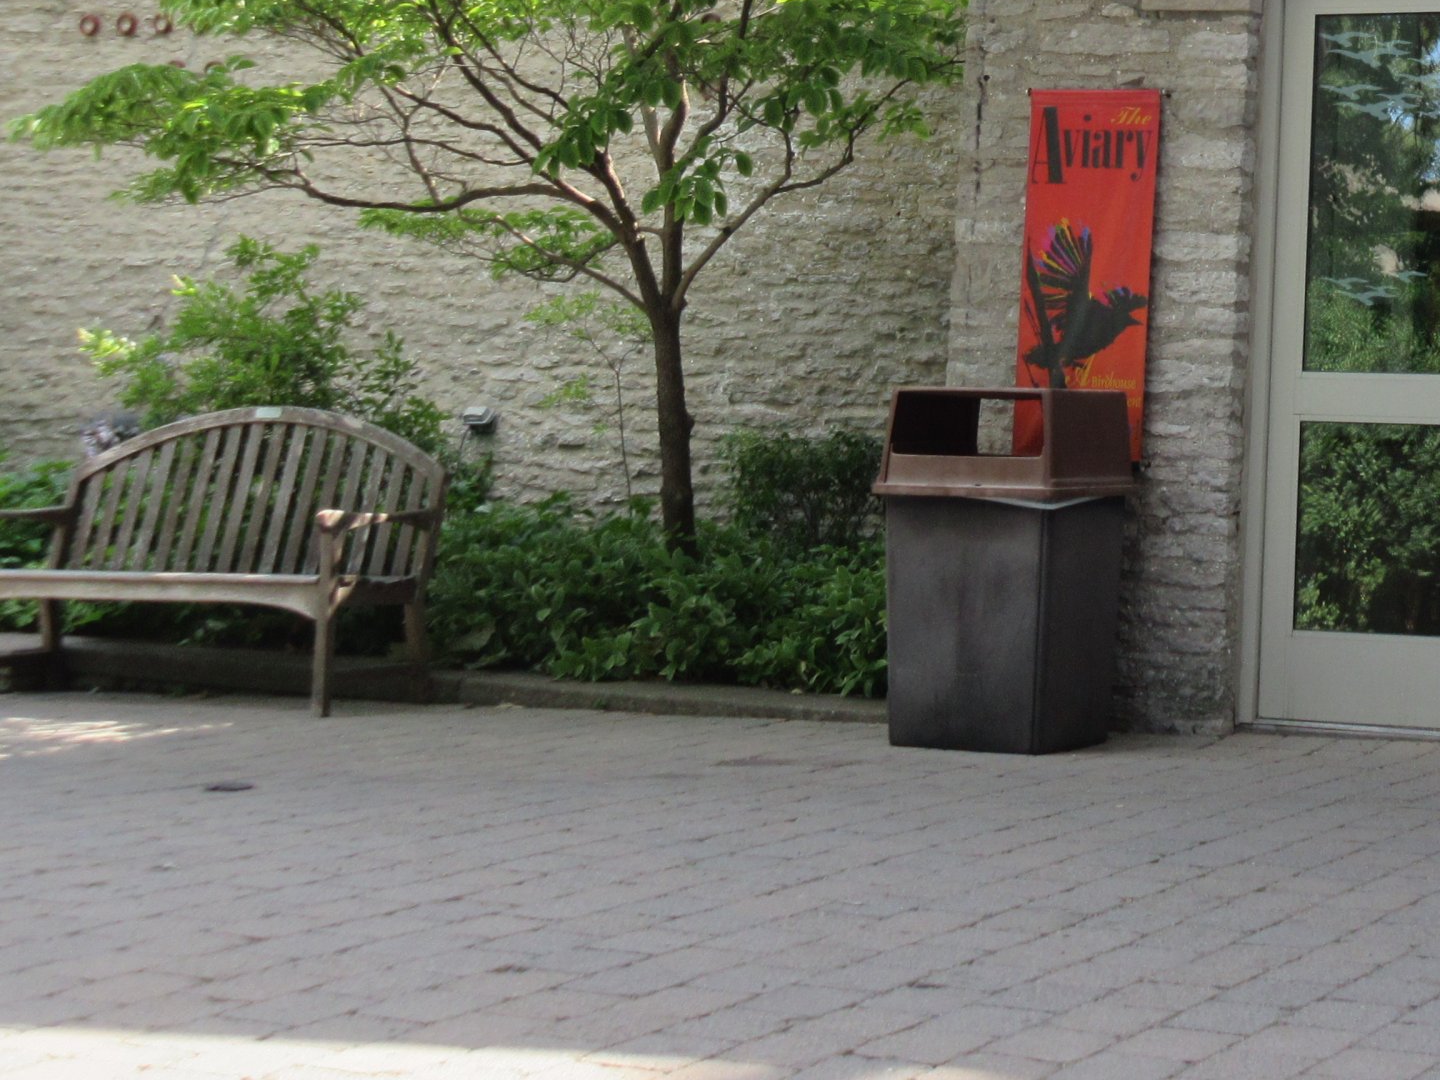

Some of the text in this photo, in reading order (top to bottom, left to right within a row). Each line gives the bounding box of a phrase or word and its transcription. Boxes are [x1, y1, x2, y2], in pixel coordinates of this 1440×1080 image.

[1110, 106, 1152, 126] The
[1032, 106, 1153, 185] Aviary
[1091, 371, 1137, 390] Birdhouse
